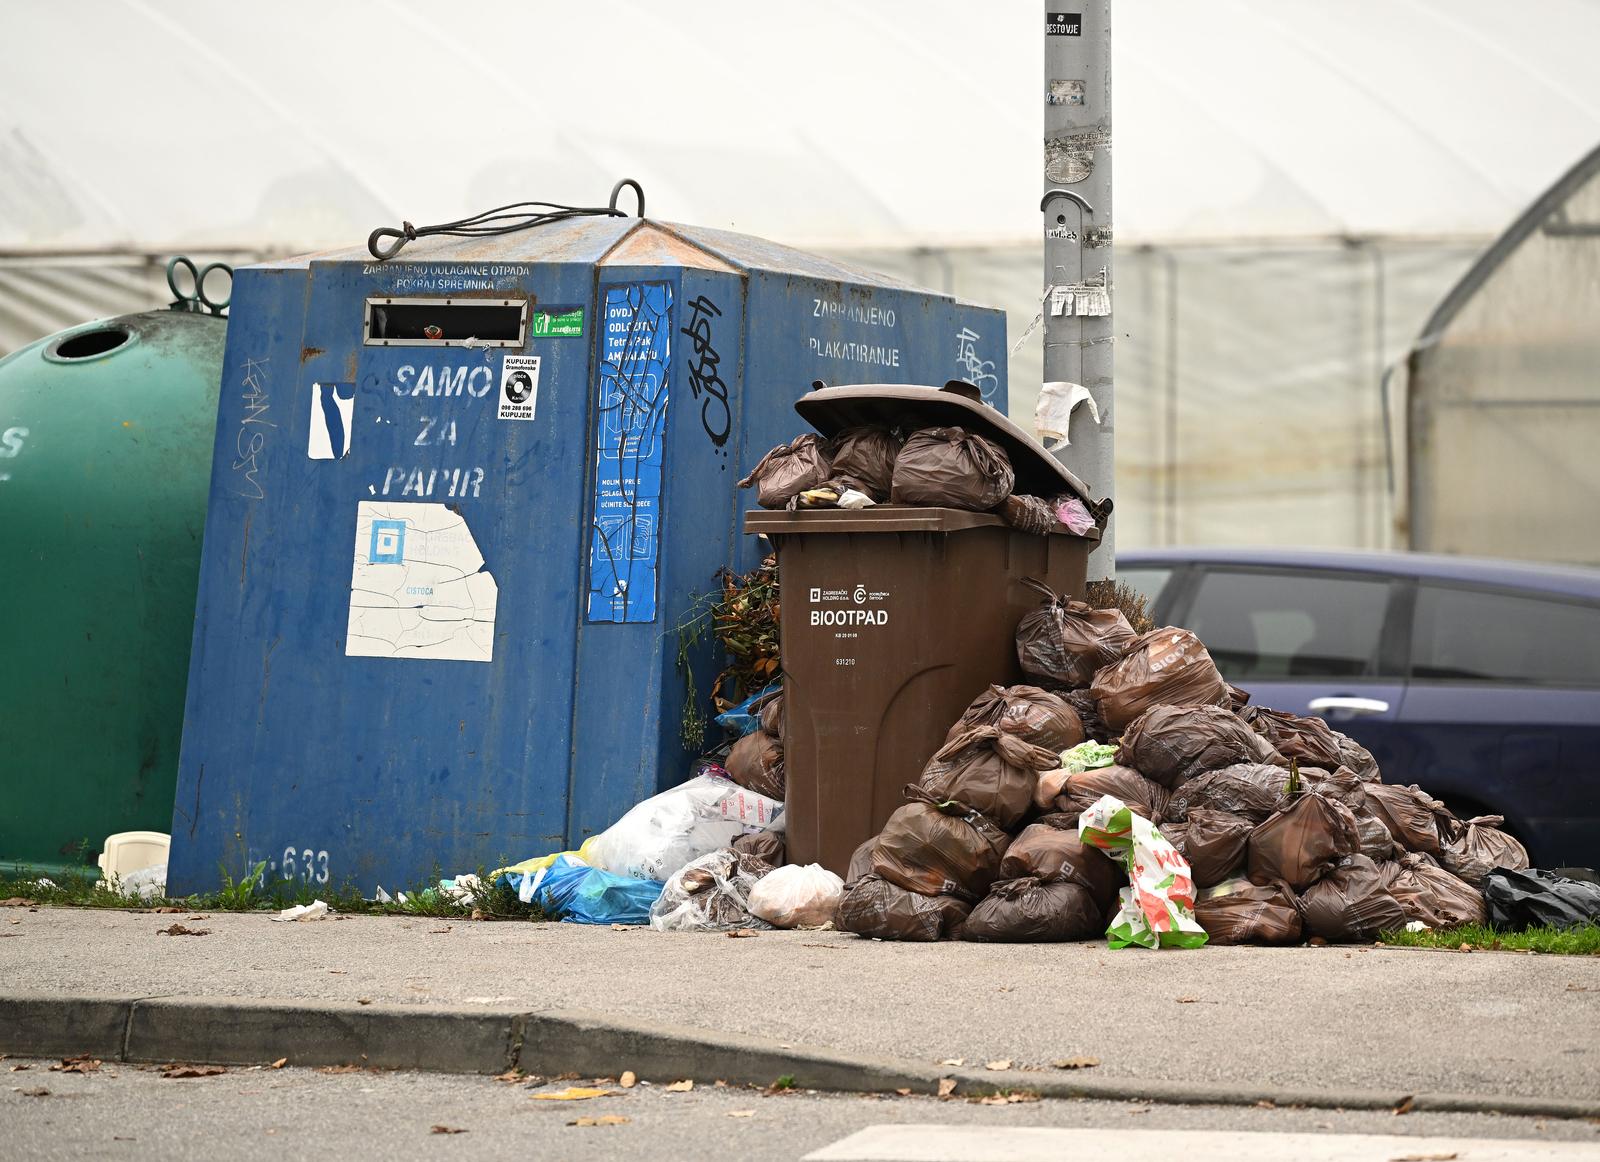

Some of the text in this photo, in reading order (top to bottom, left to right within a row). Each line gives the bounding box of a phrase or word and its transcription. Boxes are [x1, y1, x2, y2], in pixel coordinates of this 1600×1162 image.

[1046, 24, 1079, 34] BESTOVJE
[430, 264, 488, 276] ODLAGANJE
[491, 265, 529, 276] OTPADA
[396, 278, 494, 290] POKRAJ SPREMNIKA
[610, 307, 639, 318] OVDJ
[813, 299, 896, 328] ZABRANJENO
[809, 337, 900, 367] PLAKATIRANJE
[393, 364, 493, 398] SAMO
[413, 416, 457, 446] ZA
[810, 610, 889, 626] BIOOTPAD
